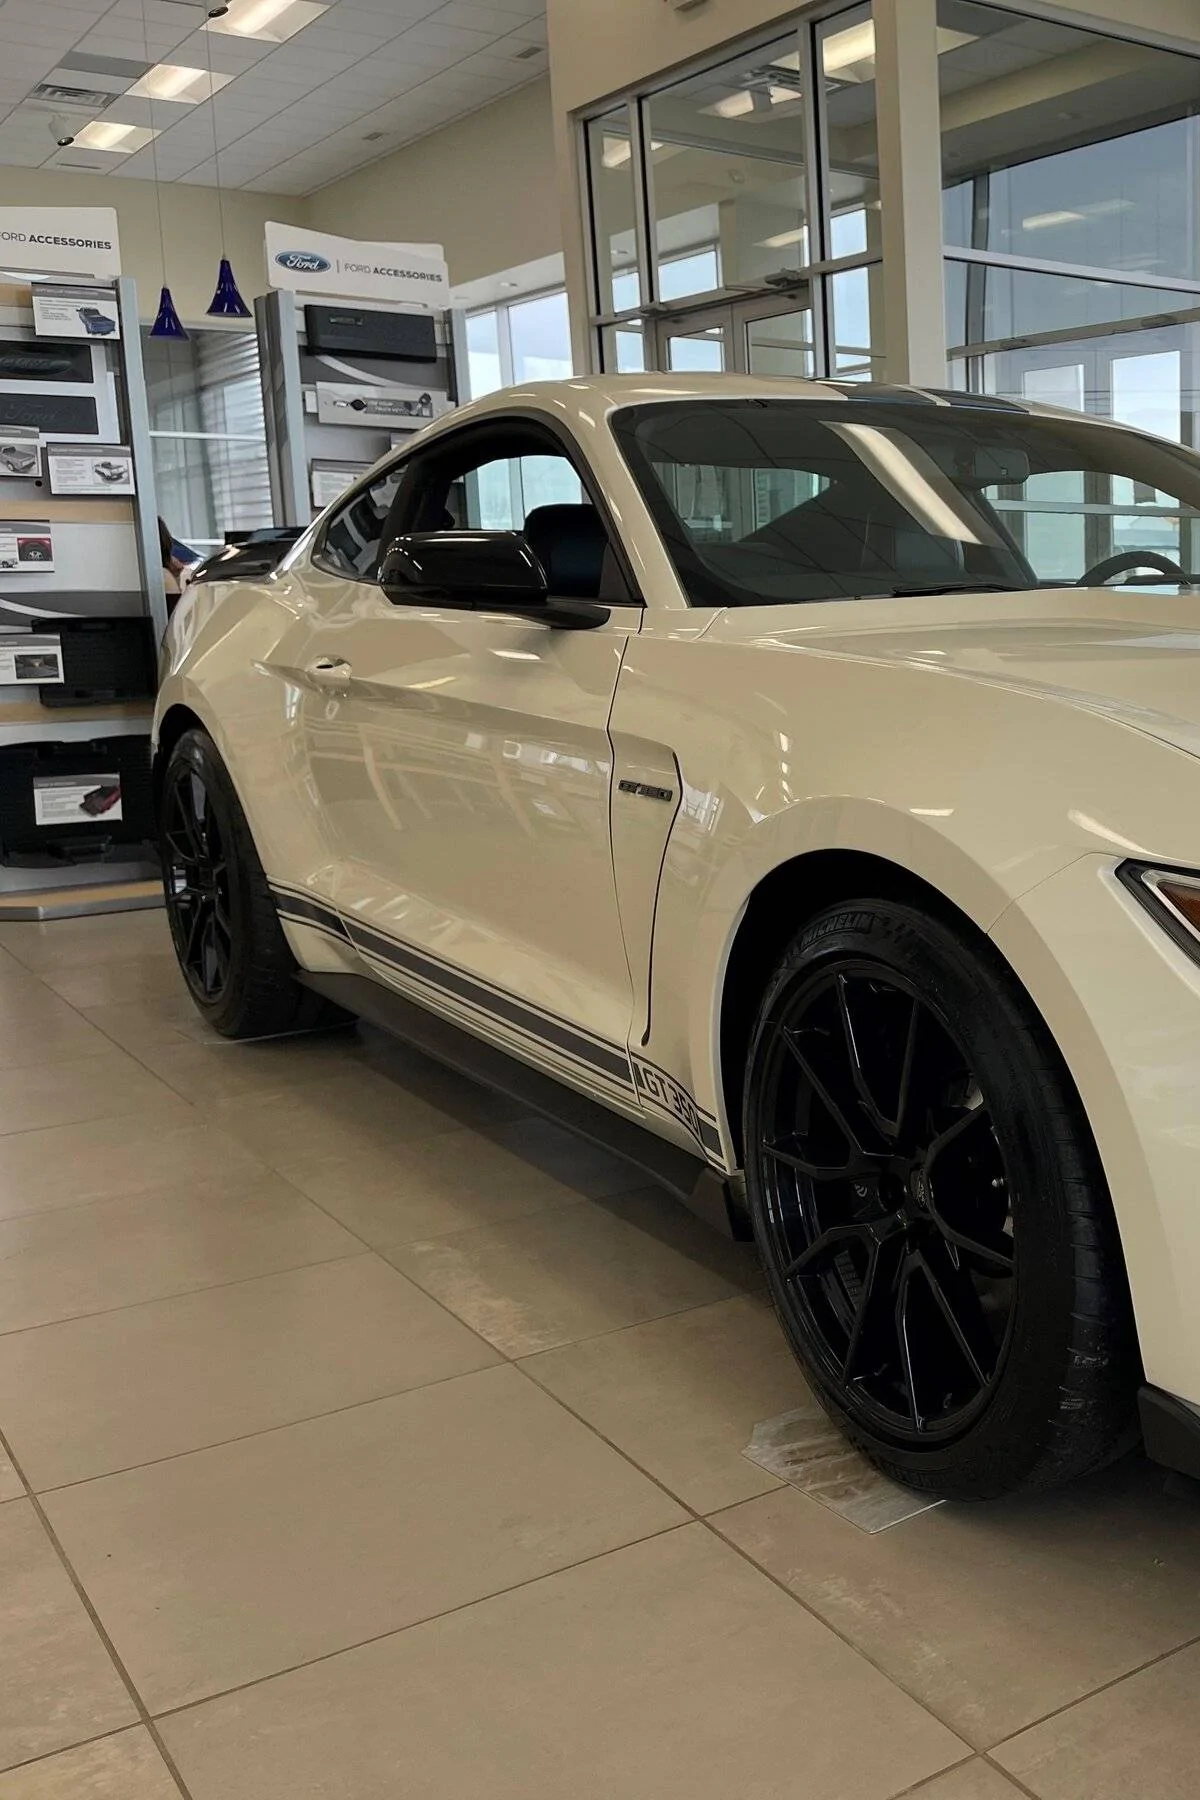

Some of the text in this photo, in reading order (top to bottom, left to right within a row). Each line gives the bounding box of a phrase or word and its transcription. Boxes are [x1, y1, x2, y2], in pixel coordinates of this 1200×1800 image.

[0, 231, 112, 250] ORD ACCESSORIES
[286, 253, 320, 270] Ford
[344, 262, 443, 282] FORD ACCESSORIES
